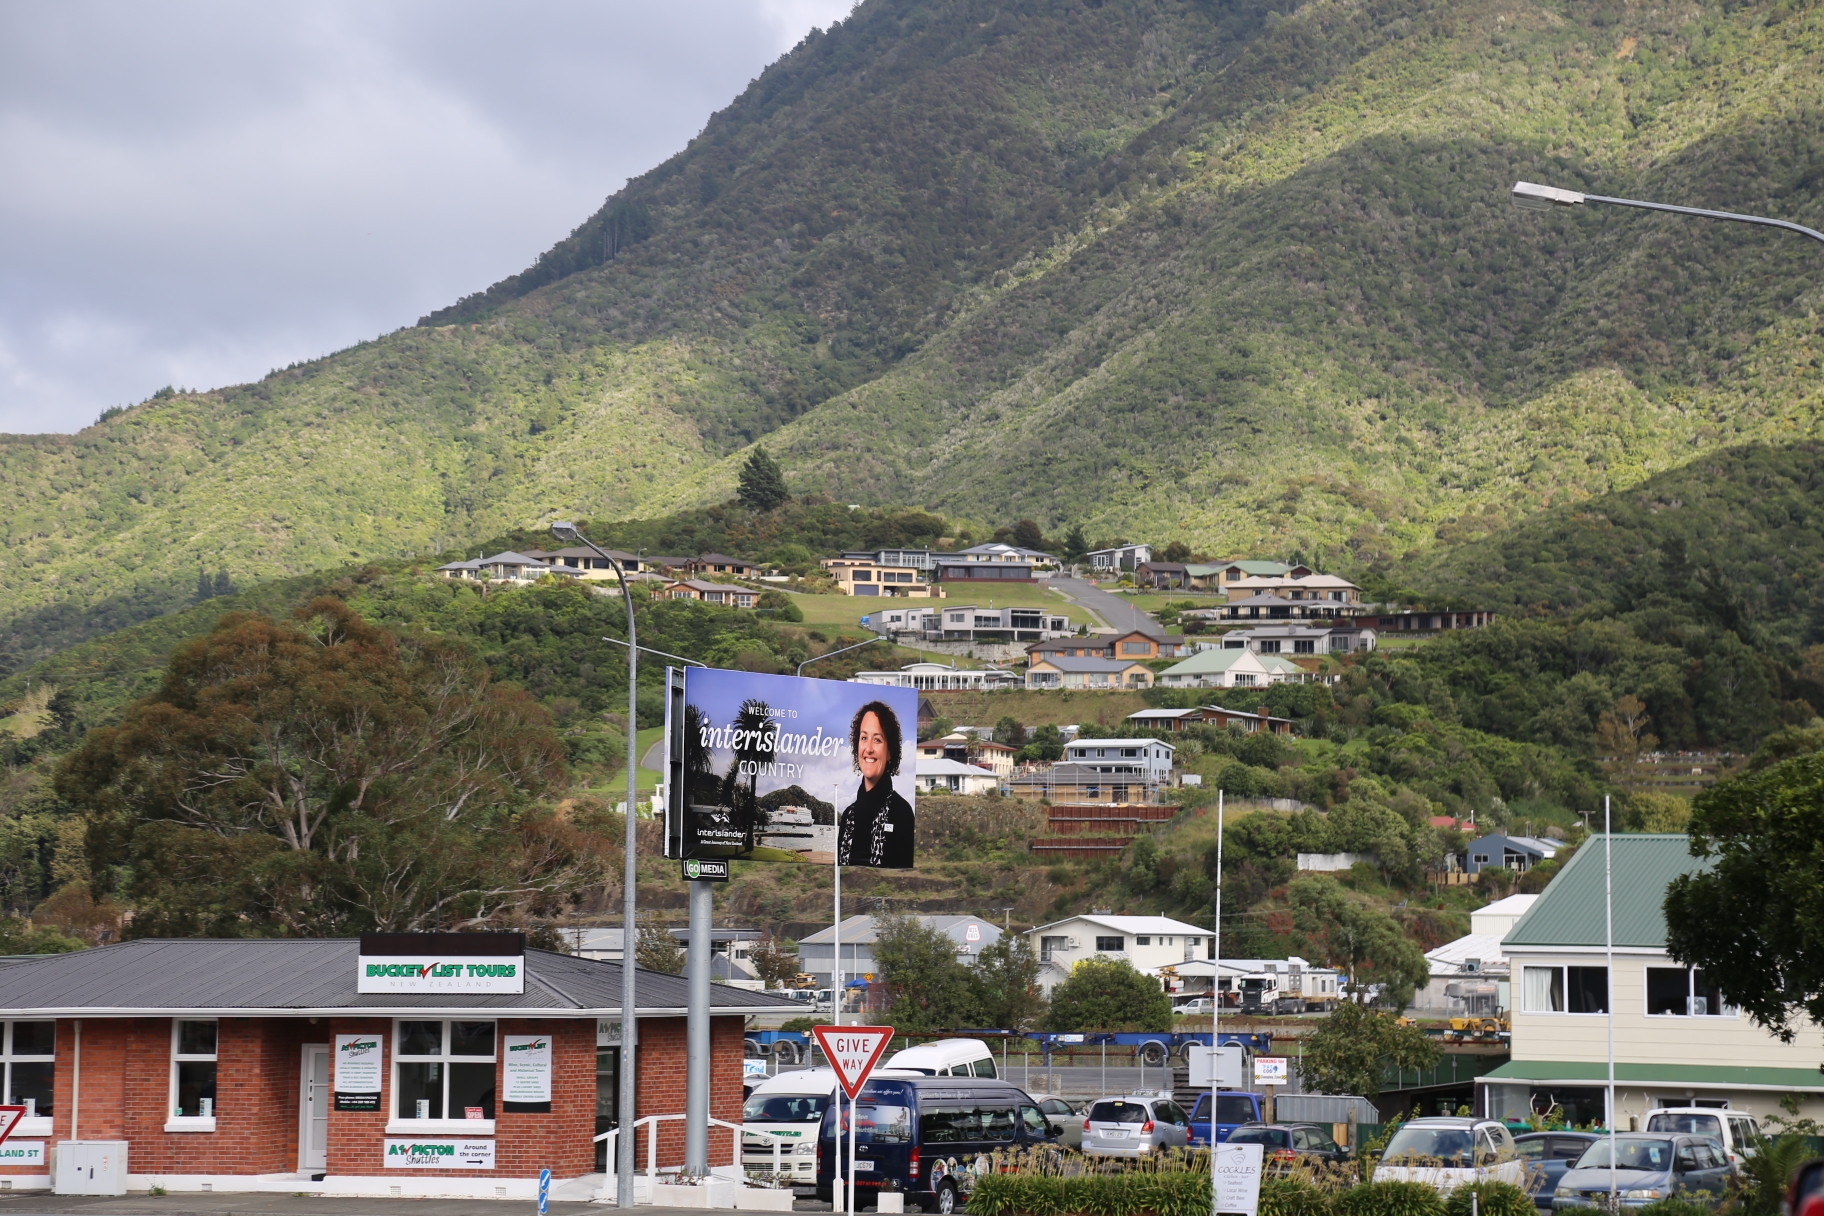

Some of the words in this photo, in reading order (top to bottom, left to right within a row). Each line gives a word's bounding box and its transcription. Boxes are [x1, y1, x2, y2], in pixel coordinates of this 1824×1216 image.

[748, 706, 786, 718] WELCOME
[788, 709, 798, 719] TO
[699, 717, 844, 757] interislander
[738, 760, 805, 779] COUNTRY
[697, 828, 746, 838] interislander
[688, 863, 700, 873] GO
[700, 864, 725, 874] MEDIA
[366, 964, 424, 977] BUCKET
[431, 964, 464, 977] LIST
[466, 964, 516, 977] TOURS
[836, 1038, 870, 1053] GIVE
[842, 1059, 863, 1070] WAY
[388, 1144, 405, 1155] A1
[411, 1144, 455, 1156] PICTON
[405, 1154, 440, 1165] Shuttles
[1217, 1166, 1256, 1174] COCKLES
